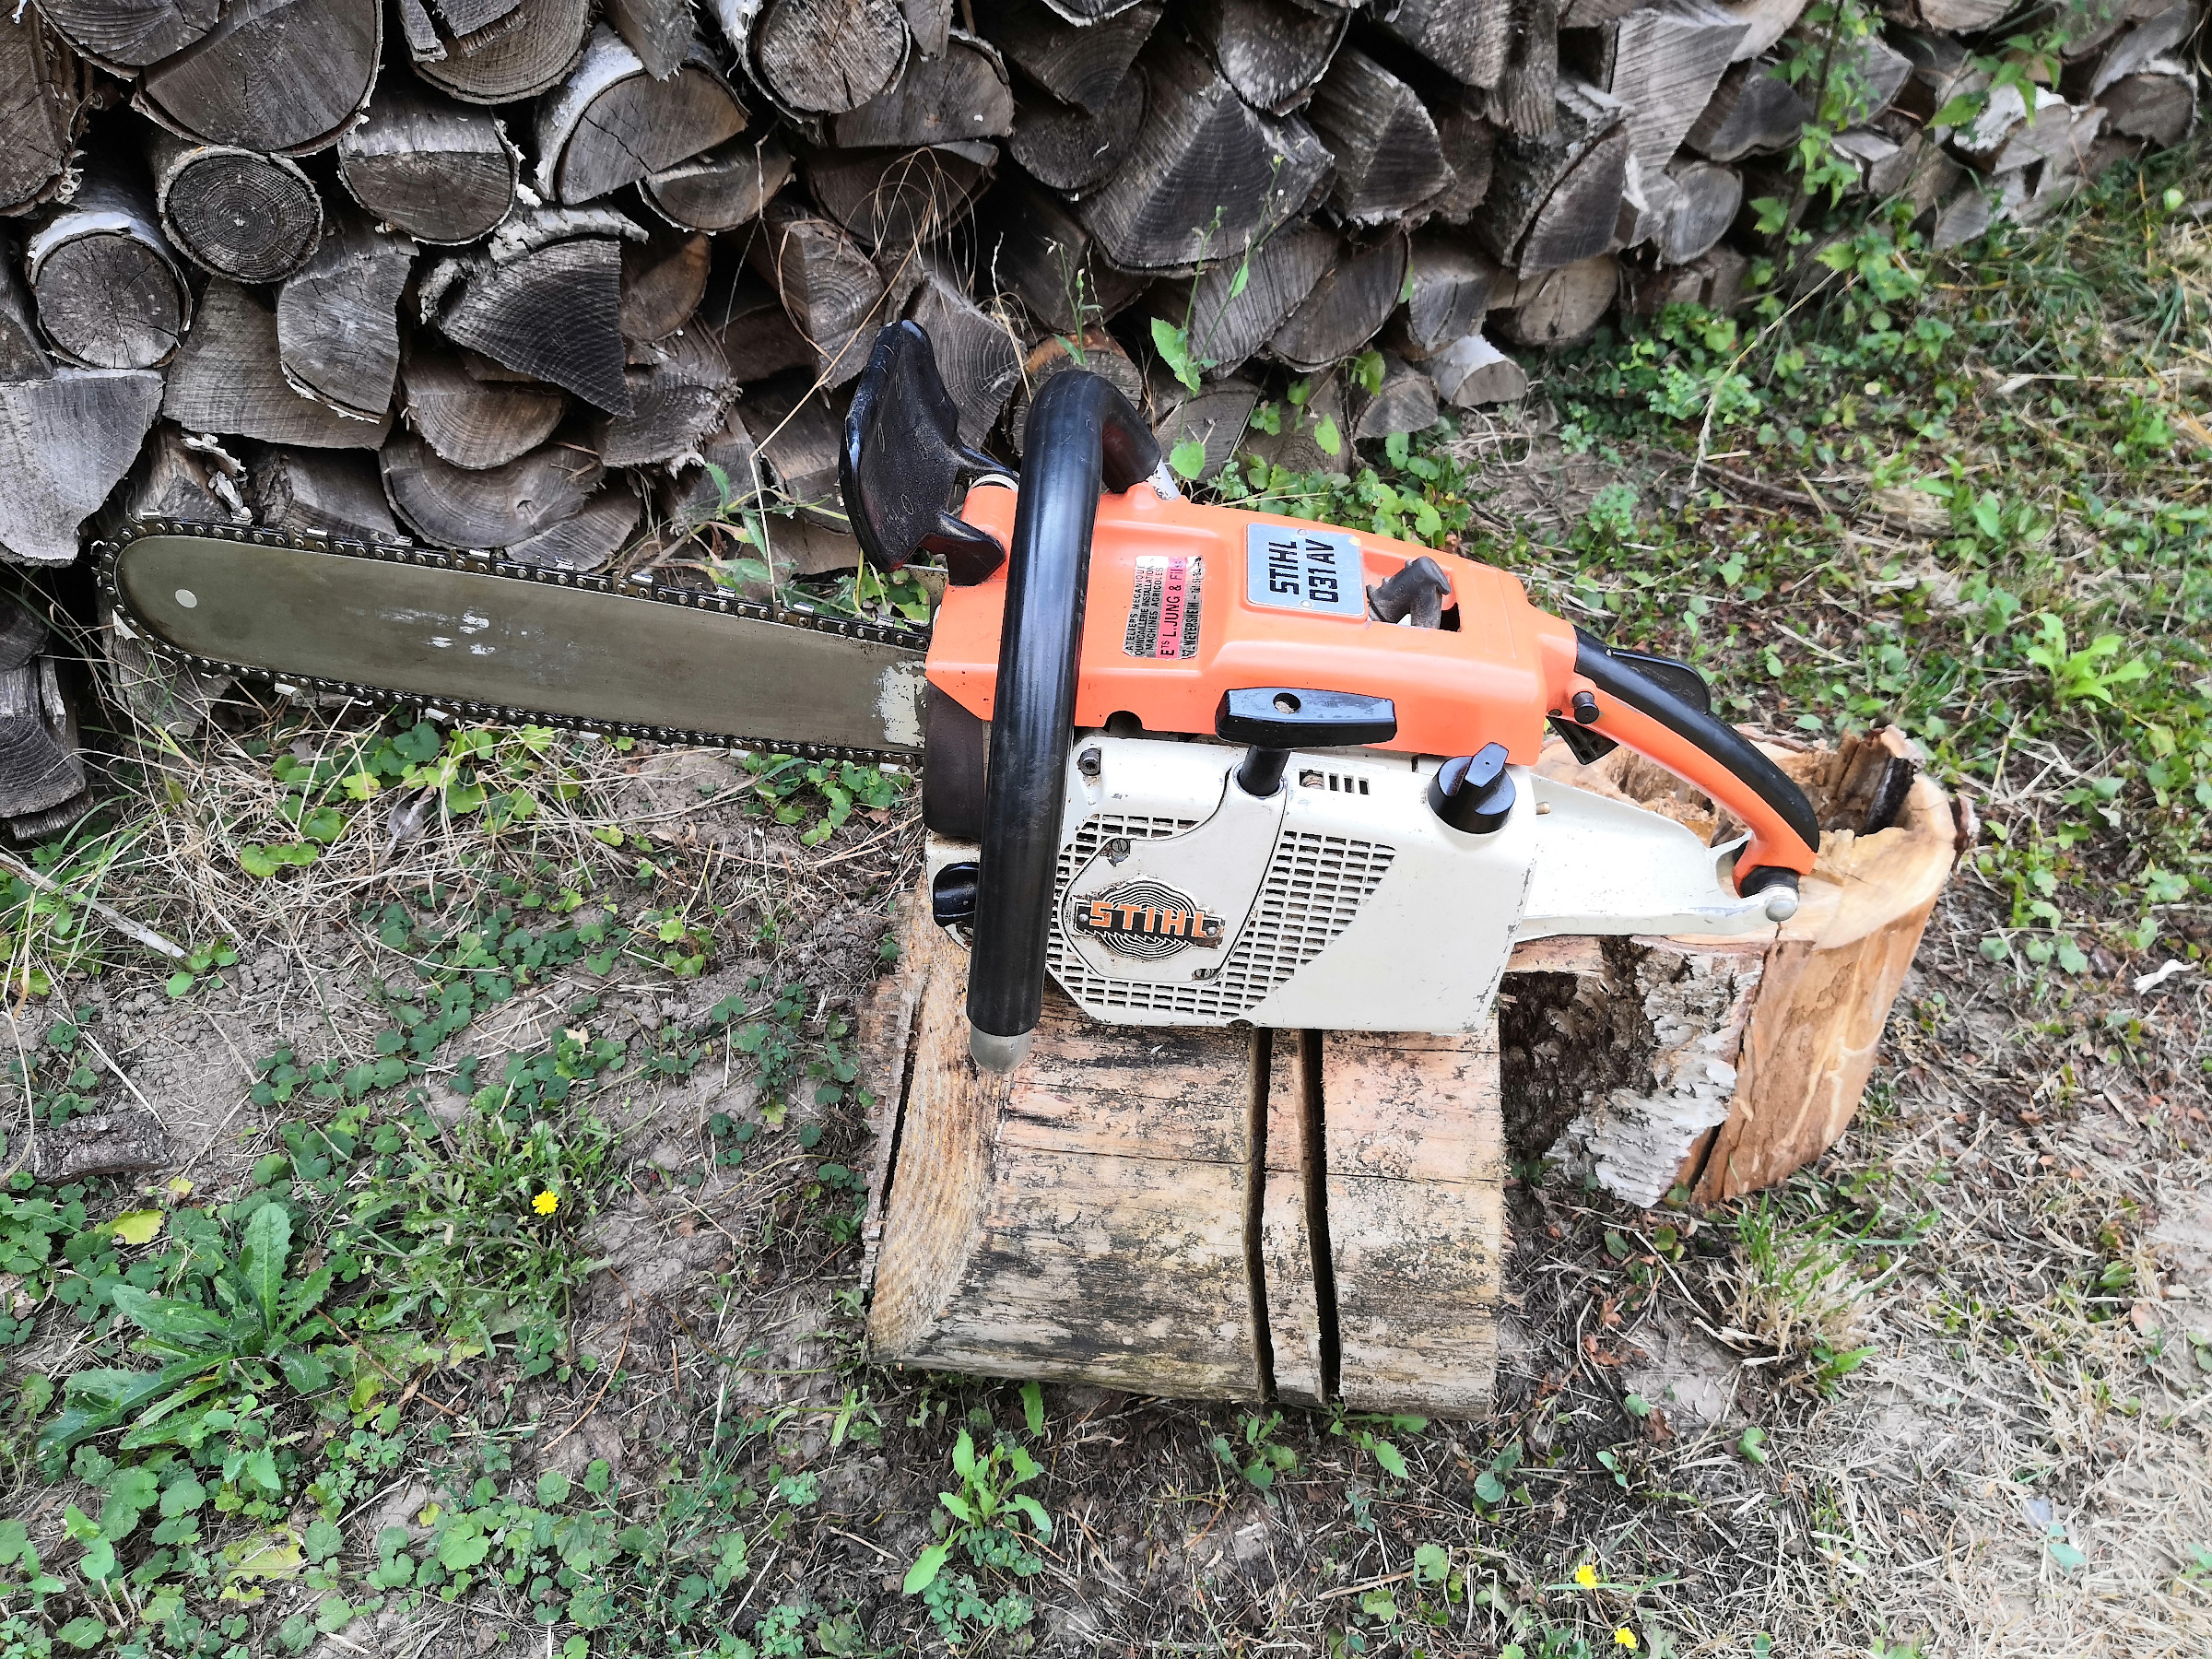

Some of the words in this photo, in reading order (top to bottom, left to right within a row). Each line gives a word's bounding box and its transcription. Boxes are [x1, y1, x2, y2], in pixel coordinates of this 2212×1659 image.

[1268, 541, 1299, 594] STIHL
[1305, 538, 1335, 565] AV
[1151, 567, 1163, 606] AGRICOLES
[1308, 568, 1339, 603] 031
[1125, 614, 1138, 651] ATELIERS
[1135, 608, 1148, 655] QUINCAILLERIE
[1146, 611, 1158, 650] MACHINES
[1089, 900, 1207, 938] STIHL
